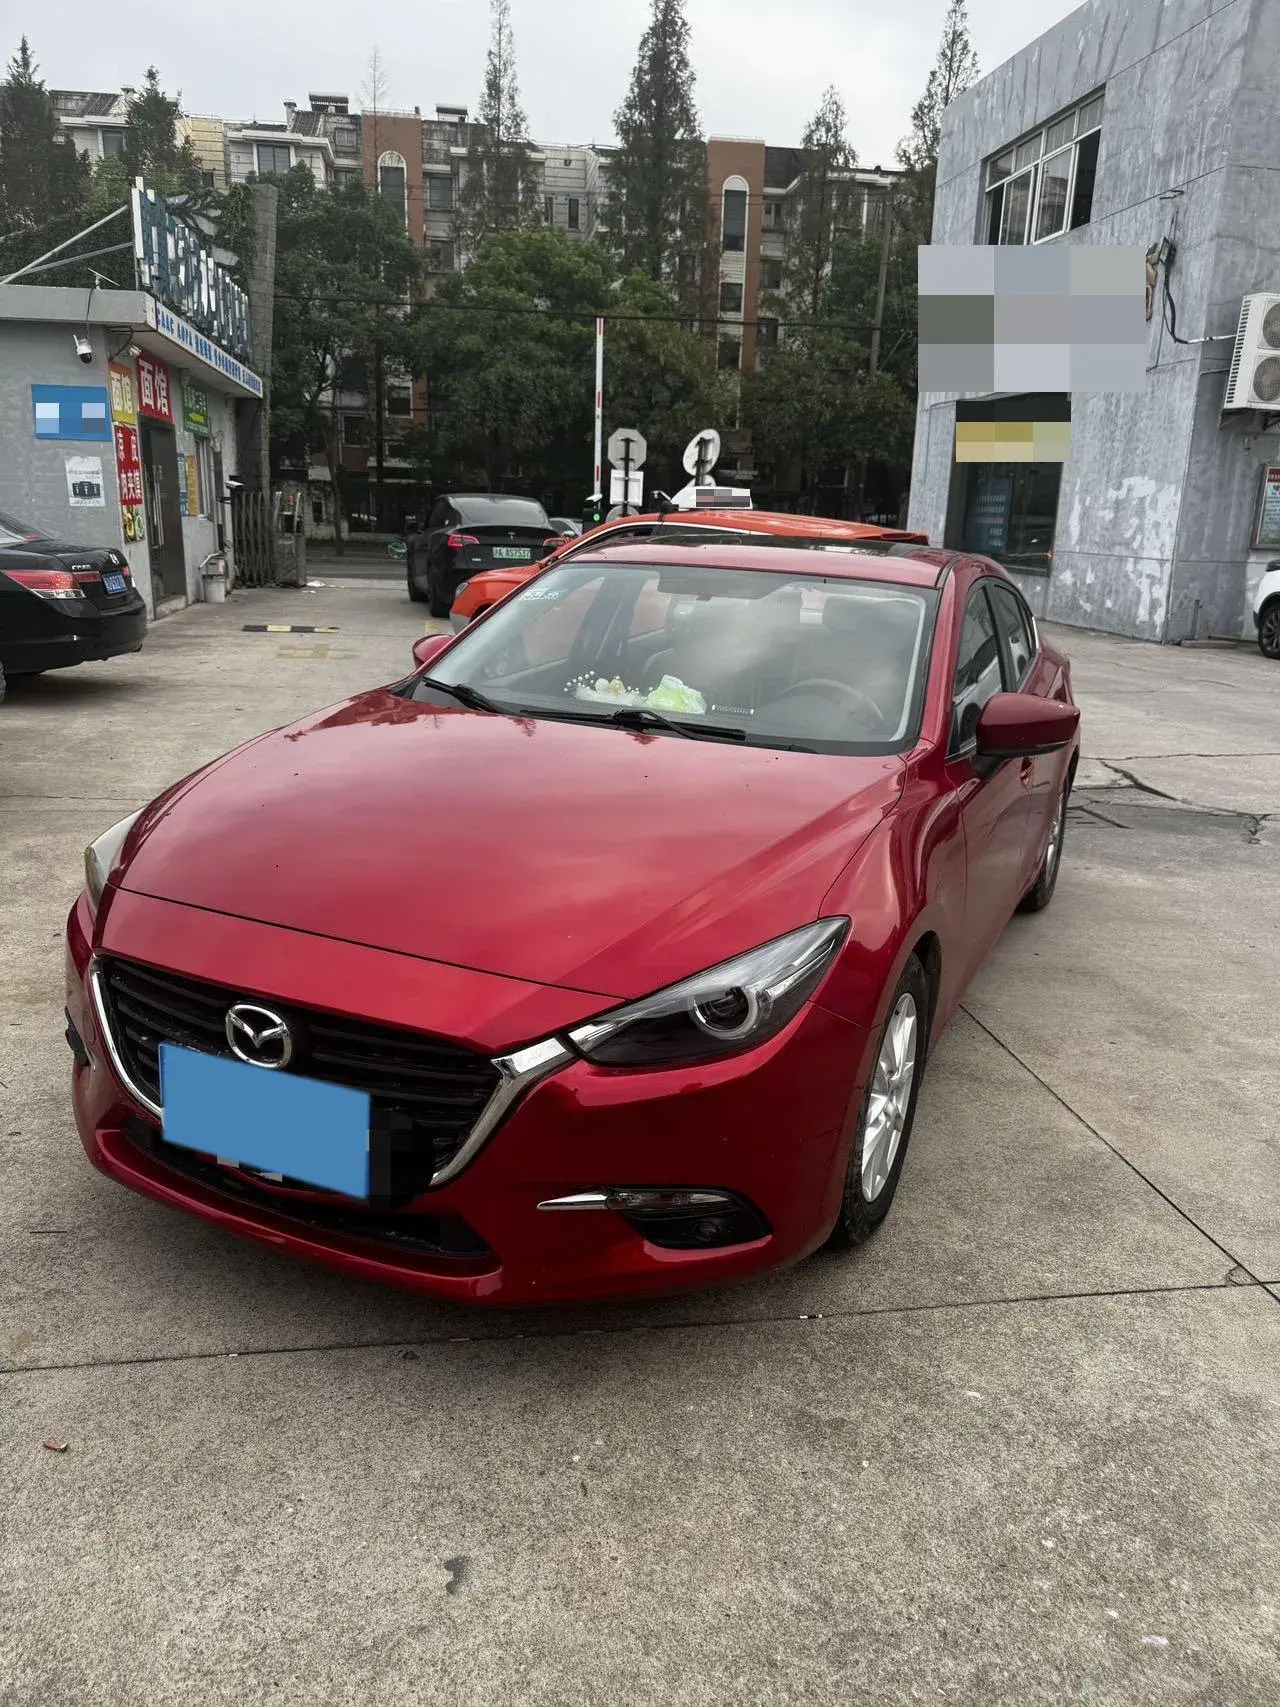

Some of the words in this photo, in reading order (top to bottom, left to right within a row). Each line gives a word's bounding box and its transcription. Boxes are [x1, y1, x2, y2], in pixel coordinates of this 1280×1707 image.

[110, 370, 133, 414] 面馆
[139, 358, 169, 416] 面馆
[120, 468, 142, 500] 肉夹馍
